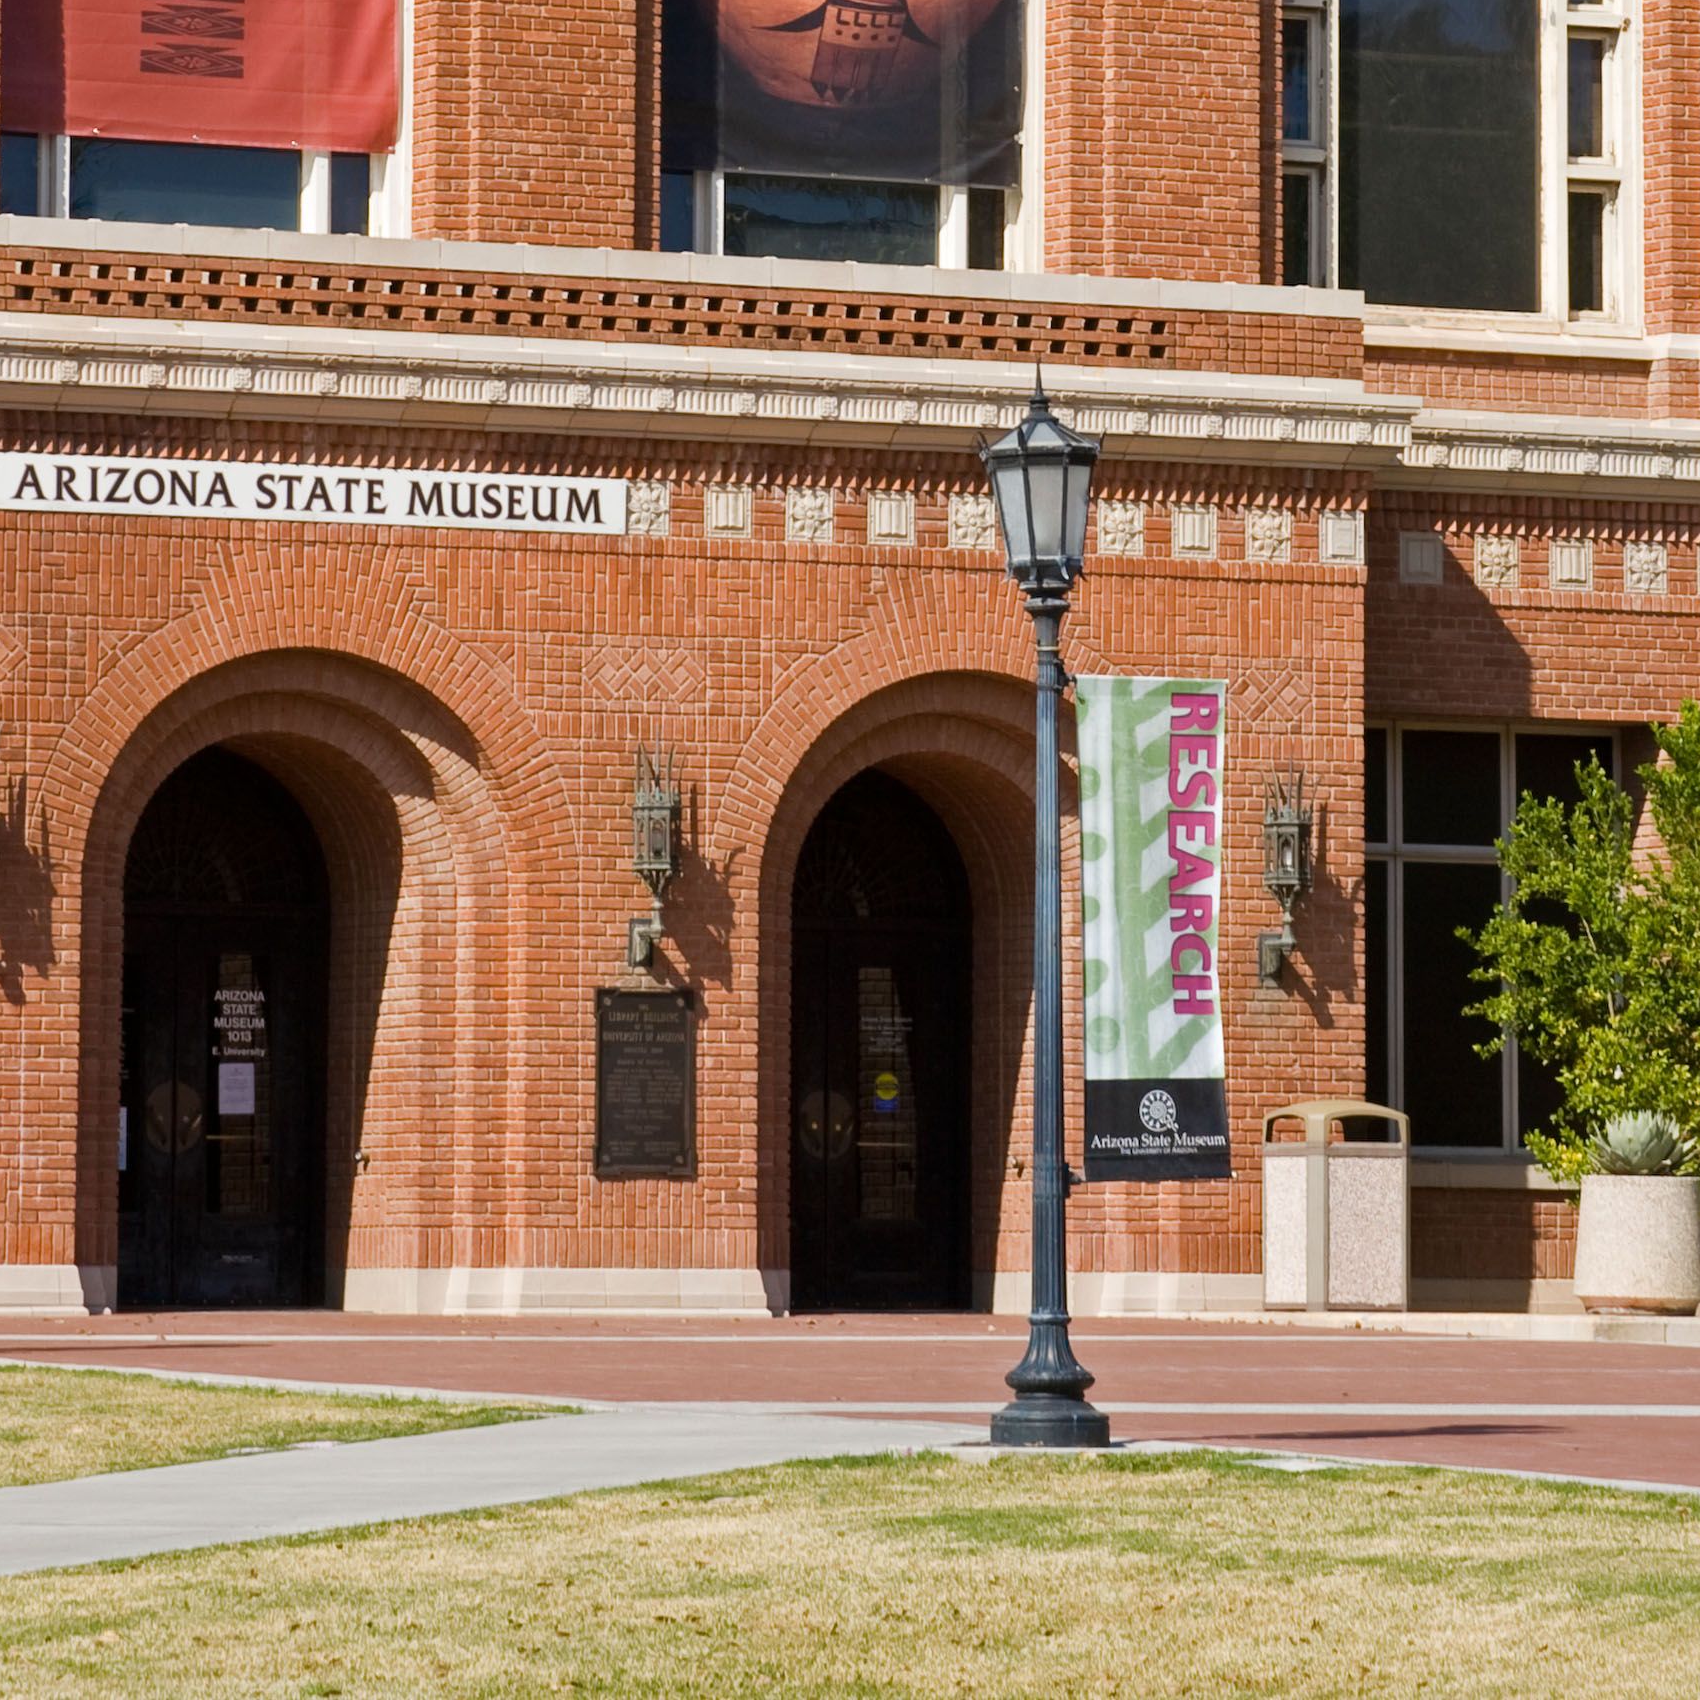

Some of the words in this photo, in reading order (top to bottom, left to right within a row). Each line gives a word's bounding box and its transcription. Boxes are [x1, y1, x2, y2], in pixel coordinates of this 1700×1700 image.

[14, 463, 238, 510] ARIZONA
[255, 473, 388, 515] STATE
[407, 481, 607, 525] MUSEUM
[1167, 691, 1220, 1016] RESEARCH
[214, 990, 265, 1002] ARIZONA
[223, 1003, 257, 1015] STATE
[214, 1016, 265, 1028] MUSEUM
[1090, 1134, 1139, 1149] Arizona
[1141, 1132, 1171, 1148] State
[1173, 1131, 1227, 1147] Museum
